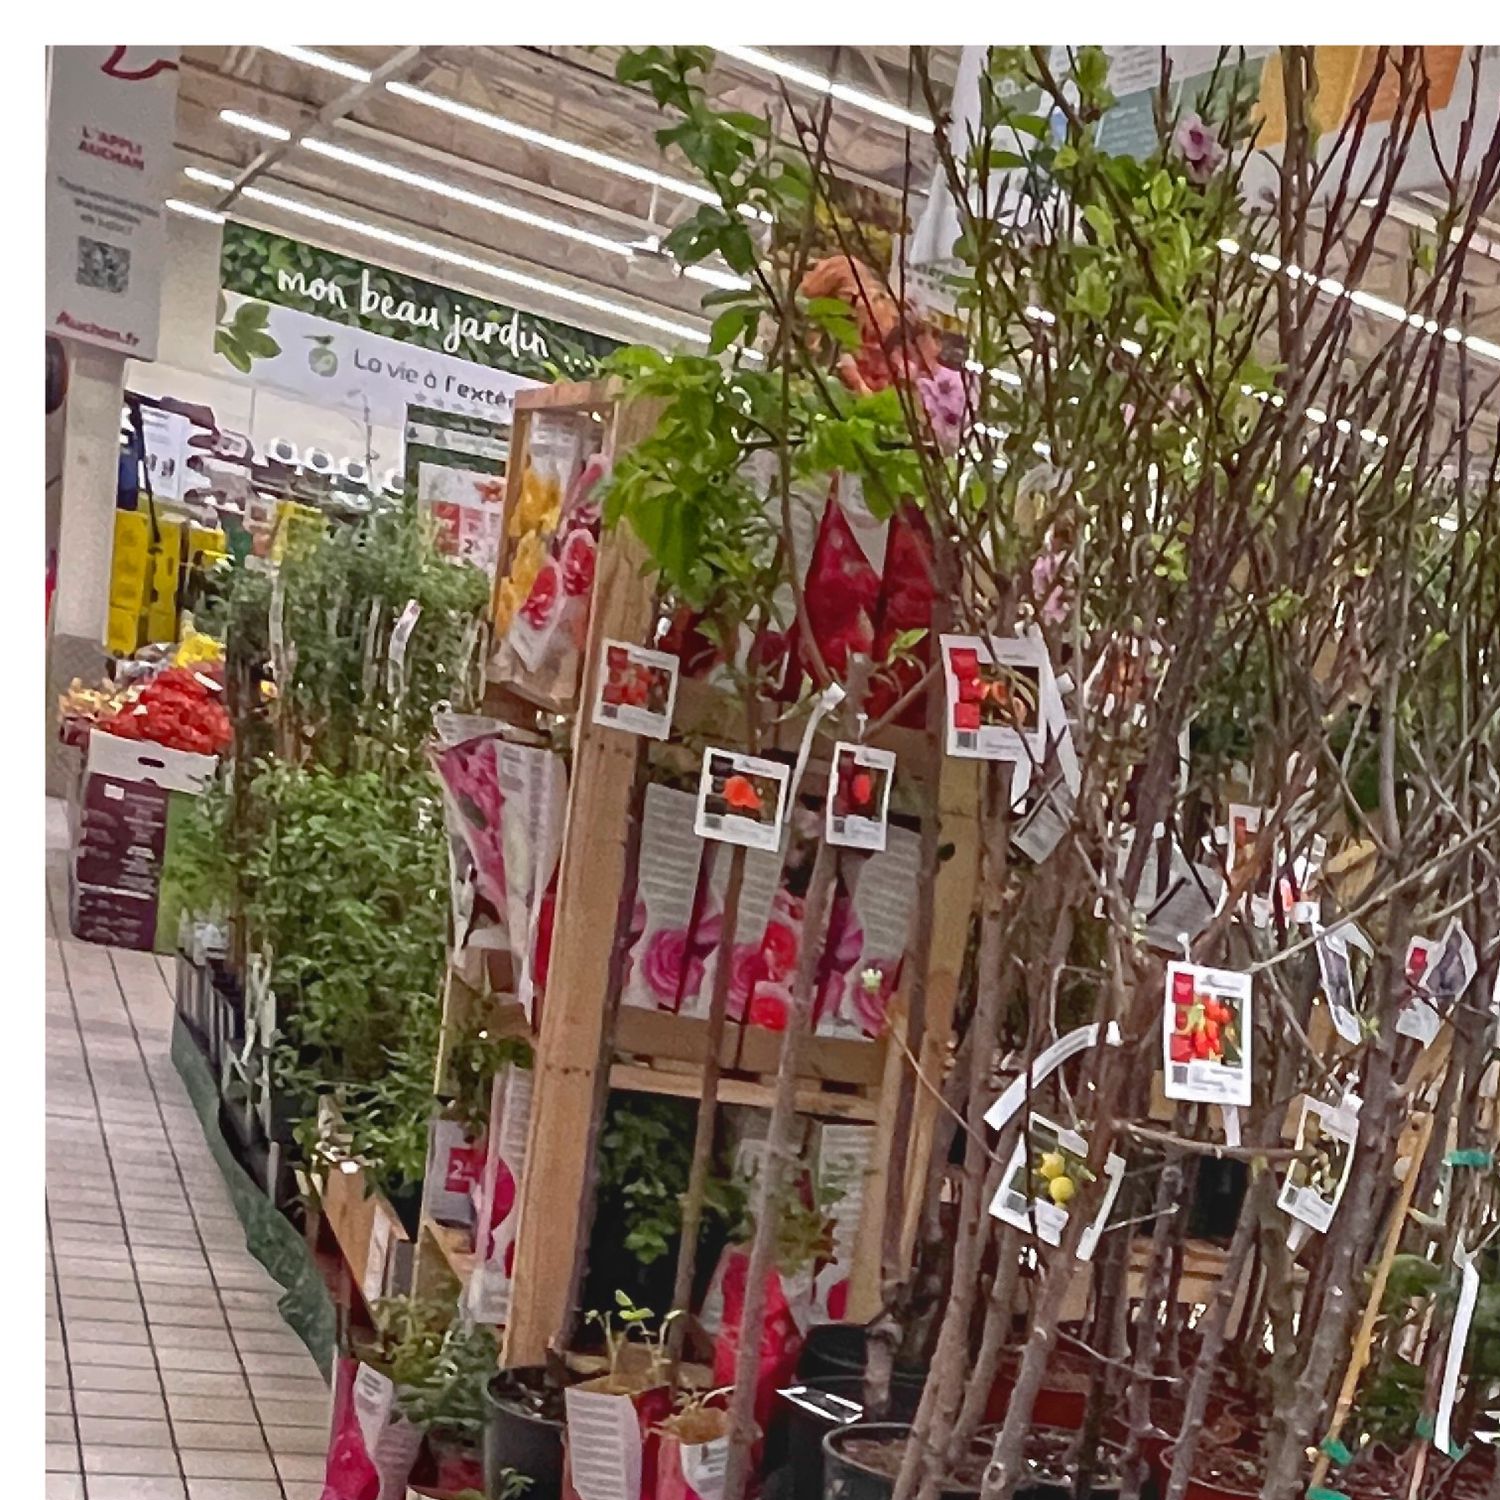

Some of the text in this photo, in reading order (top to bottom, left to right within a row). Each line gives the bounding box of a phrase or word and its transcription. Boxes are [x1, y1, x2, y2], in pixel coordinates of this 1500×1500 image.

[277, 268, 348, 309] mon
[359, 268, 440, 332] beau
[443, 304, 550, 359] jardin
[353, 348, 383, 374] La
[387, 361, 419, 384] vie
